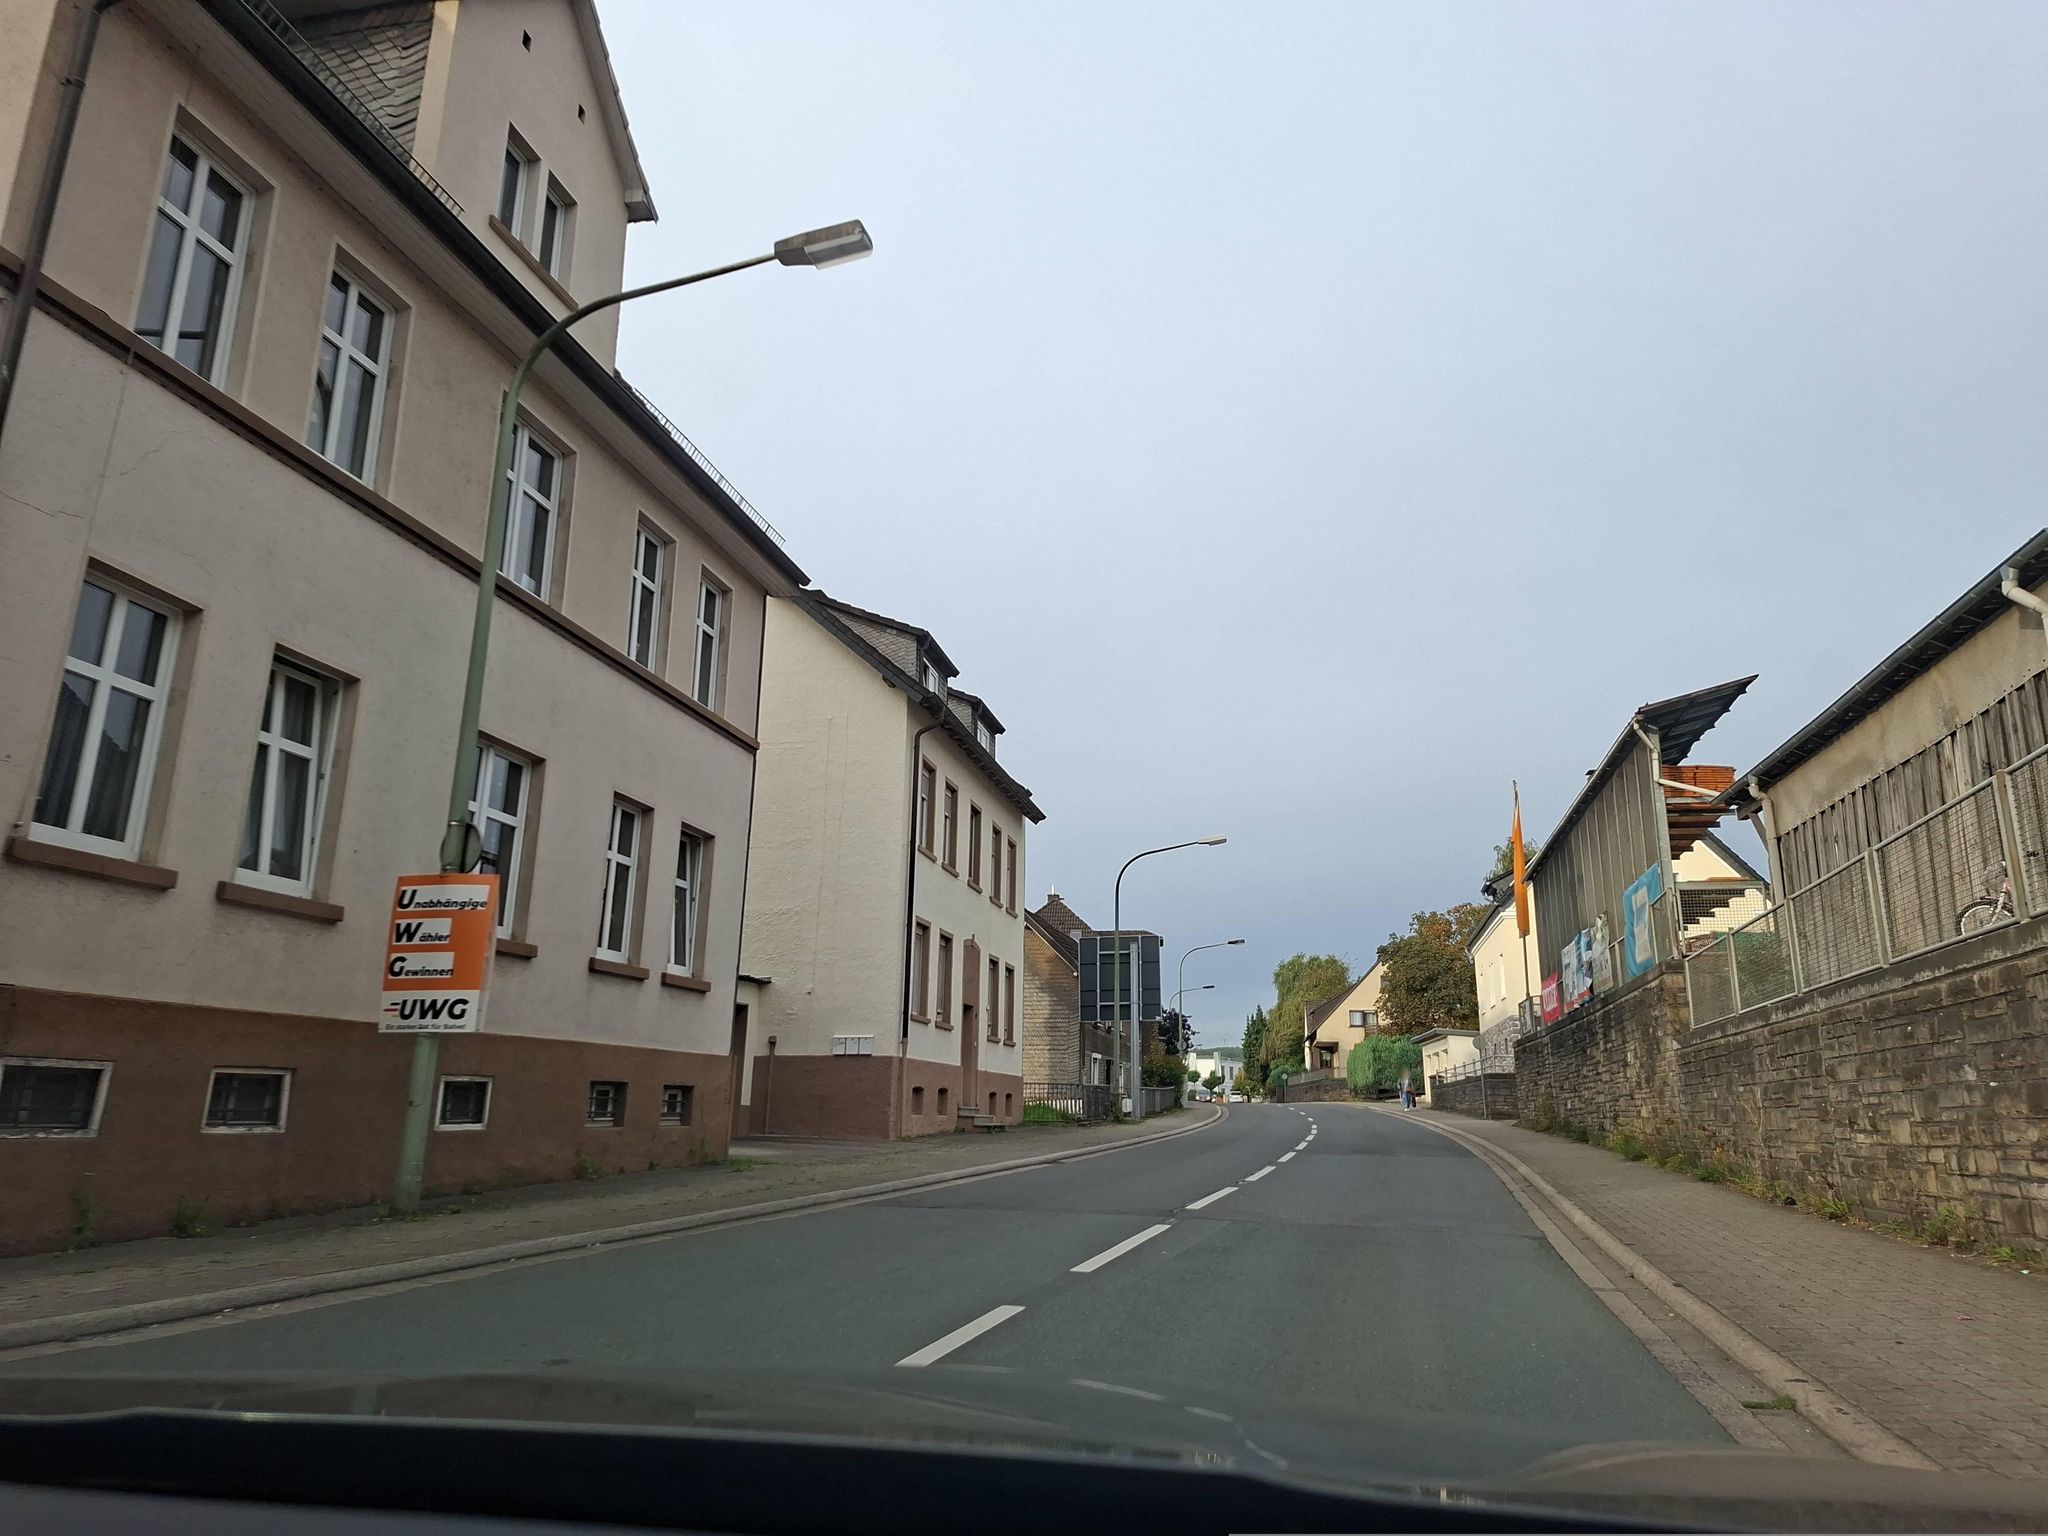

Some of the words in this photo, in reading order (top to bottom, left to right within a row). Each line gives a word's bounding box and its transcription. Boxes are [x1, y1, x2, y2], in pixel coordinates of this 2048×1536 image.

[398, 889, 488, 910] Unabhängige
[394, 922, 450, 943] Wähler
[389, 956, 454, 977] Gewinnen
[400, 998, 470, 1021] UWG
